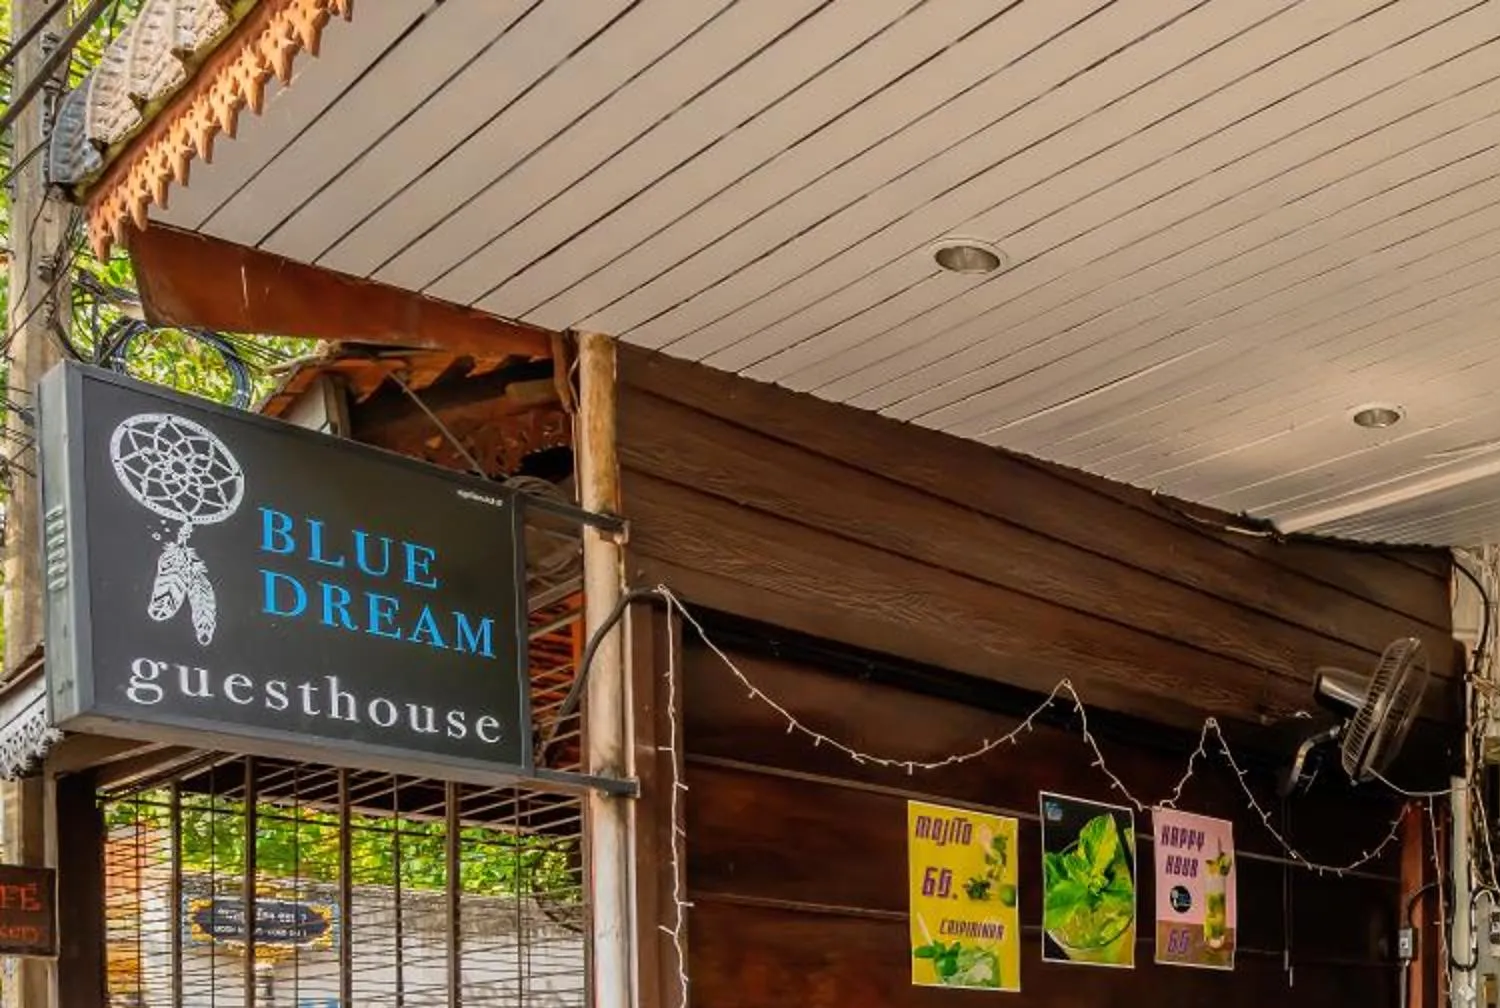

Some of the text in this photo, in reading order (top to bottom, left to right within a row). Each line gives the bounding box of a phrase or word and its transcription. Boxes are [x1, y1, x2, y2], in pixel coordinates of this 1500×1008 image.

[258, 506, 438, 590] BLUE
[259, 569, 497, 660] DREAM
[126, 655, 502, 745] guesthouse
[1160, 825, 1206, 852] HAPPY
